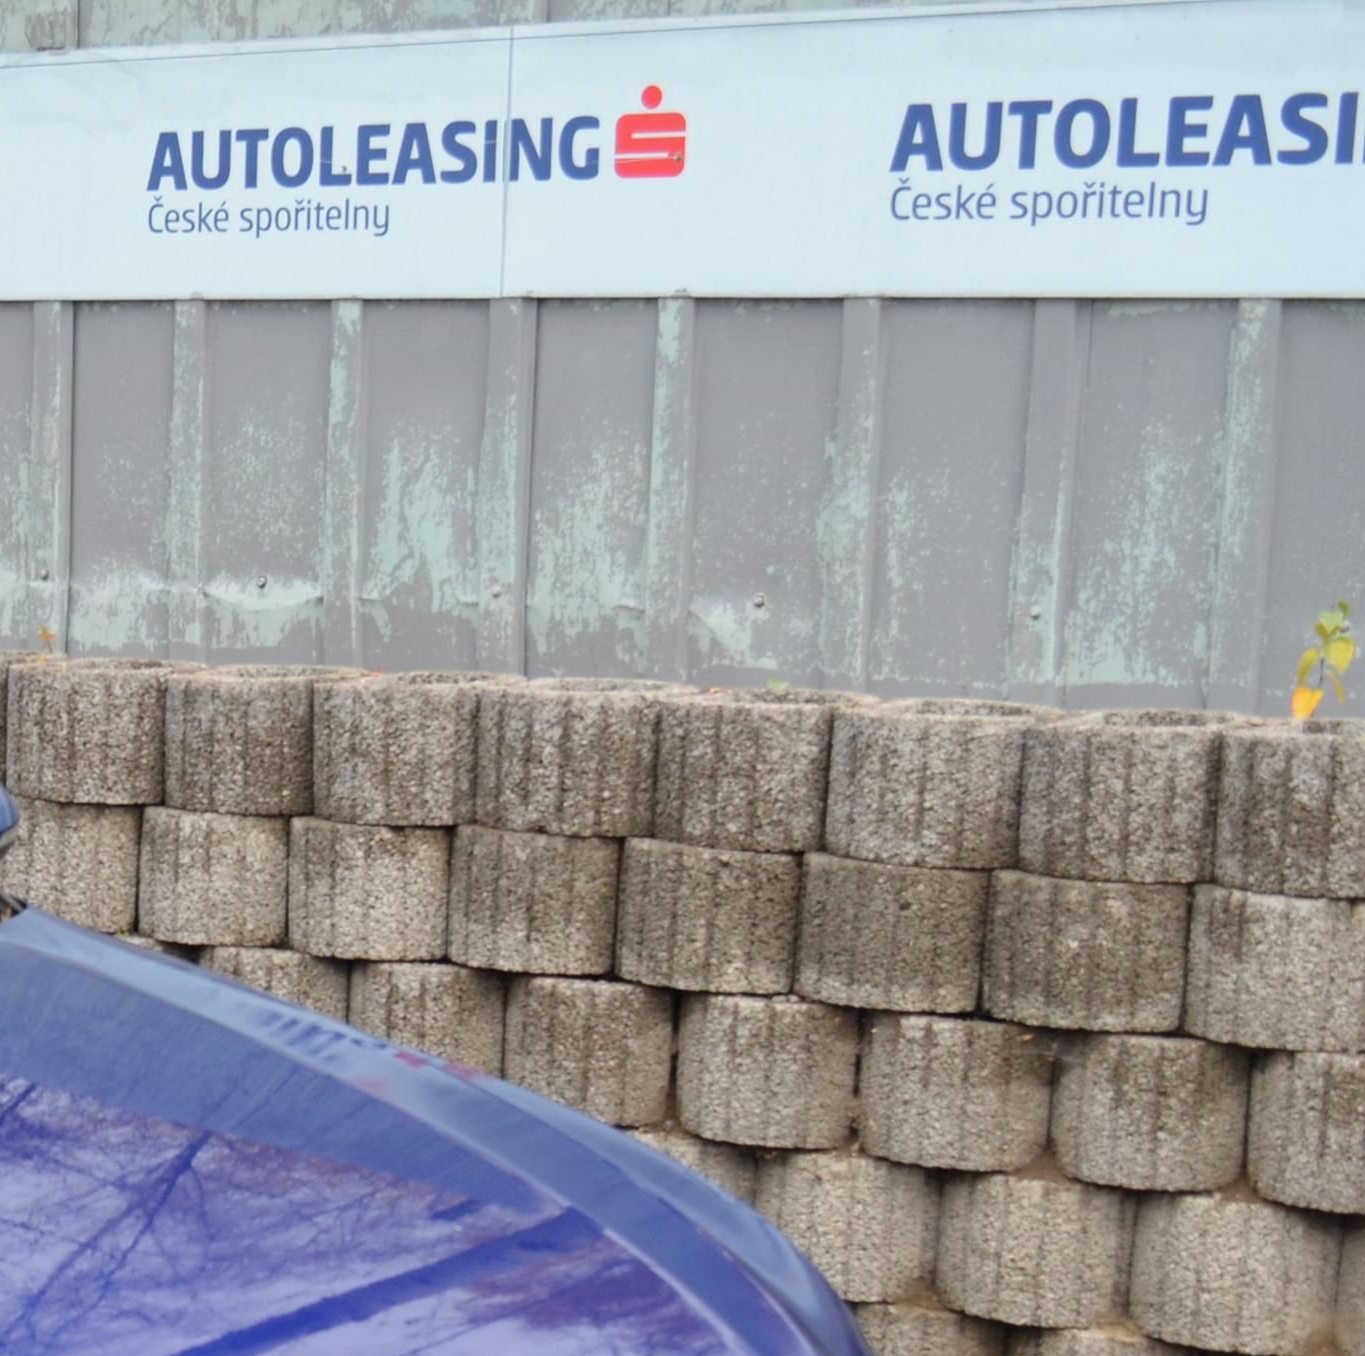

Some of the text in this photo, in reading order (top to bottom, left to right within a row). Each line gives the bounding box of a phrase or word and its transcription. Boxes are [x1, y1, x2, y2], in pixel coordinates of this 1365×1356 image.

[147, 116, 599, 191] AUTOLEASING
[890, 92, 1365, 172] AUTOLEASI
[148, 196, 389, 239] České spořitelny
[890, 178, 1209, 227] České spořitelny
